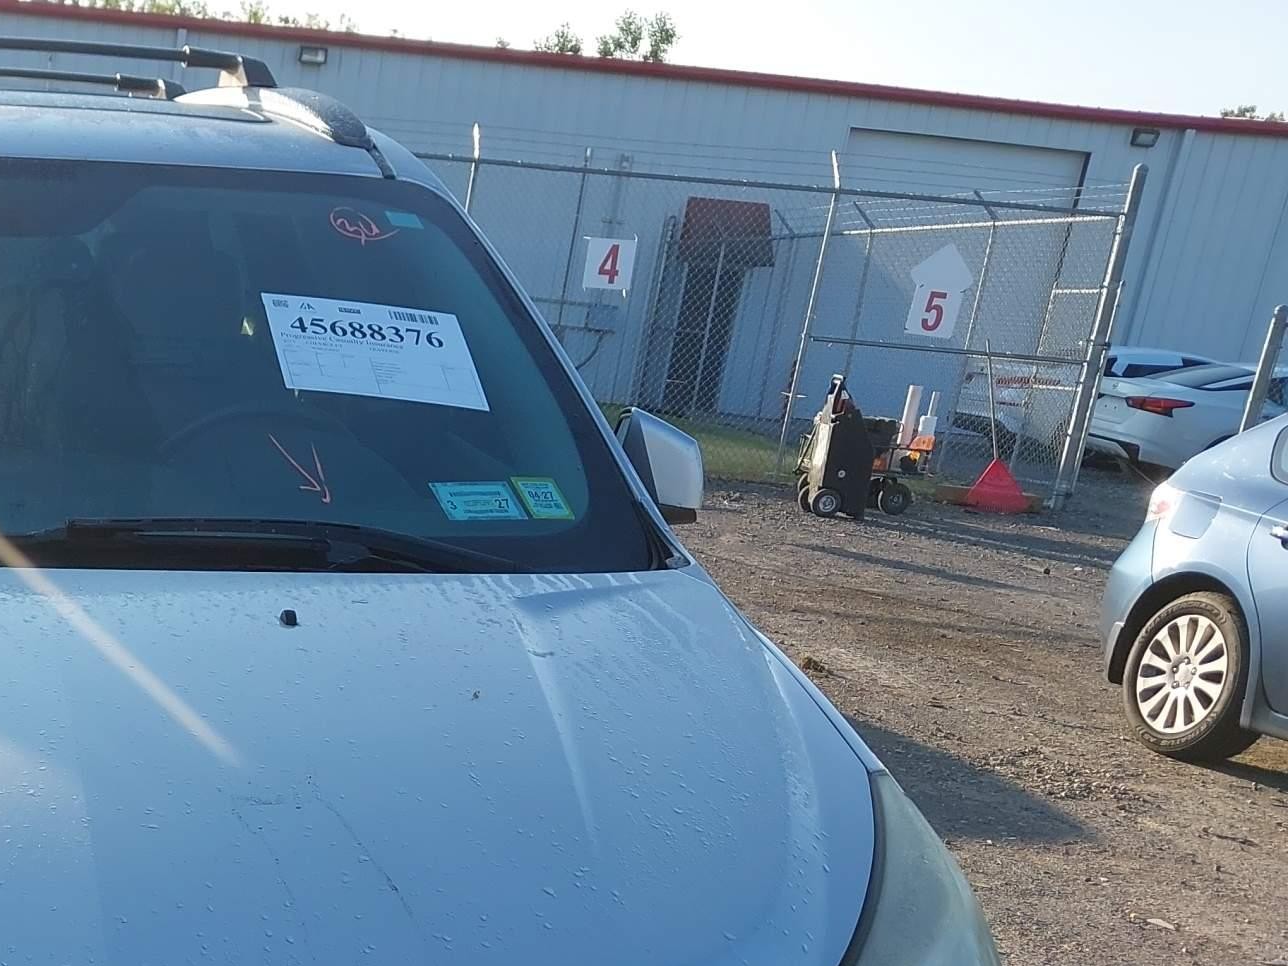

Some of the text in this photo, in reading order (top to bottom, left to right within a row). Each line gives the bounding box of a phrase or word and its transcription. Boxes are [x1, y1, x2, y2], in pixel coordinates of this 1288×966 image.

[597, 243, 621, 285] 4
[920, 290, 949, 332] 5
[289, 315, 445, 350] 45688376
[494, 498, 510, 510] 27
